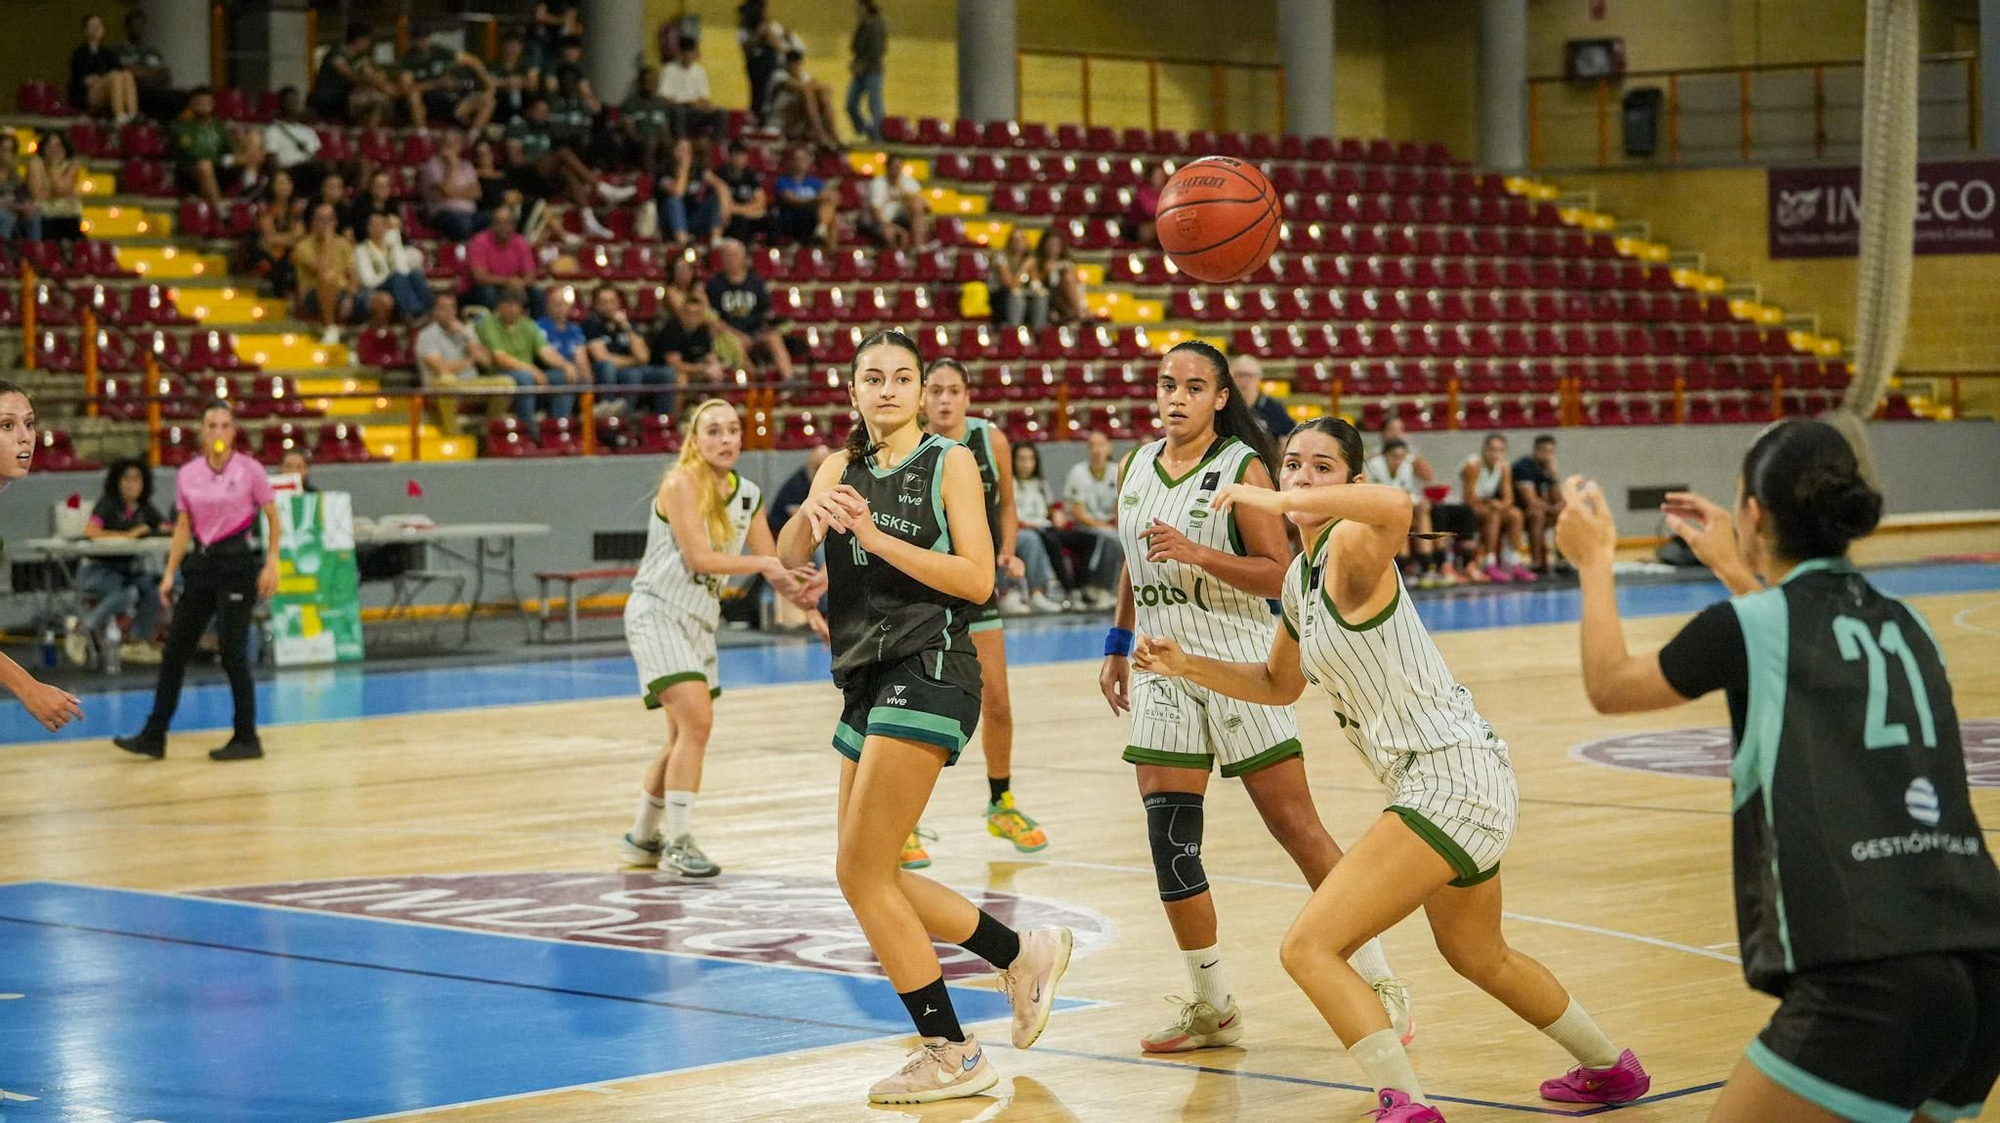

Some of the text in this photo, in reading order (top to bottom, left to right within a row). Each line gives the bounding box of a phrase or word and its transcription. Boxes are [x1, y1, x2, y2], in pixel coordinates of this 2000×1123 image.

[1826, 180, 1996, 225] IECO
[898, 493, 922, 506] vive
[871, 511, 921, 537] ASKET
[1832, 615, 1937, 749] 21
[886, 697, 907, 706] vive
